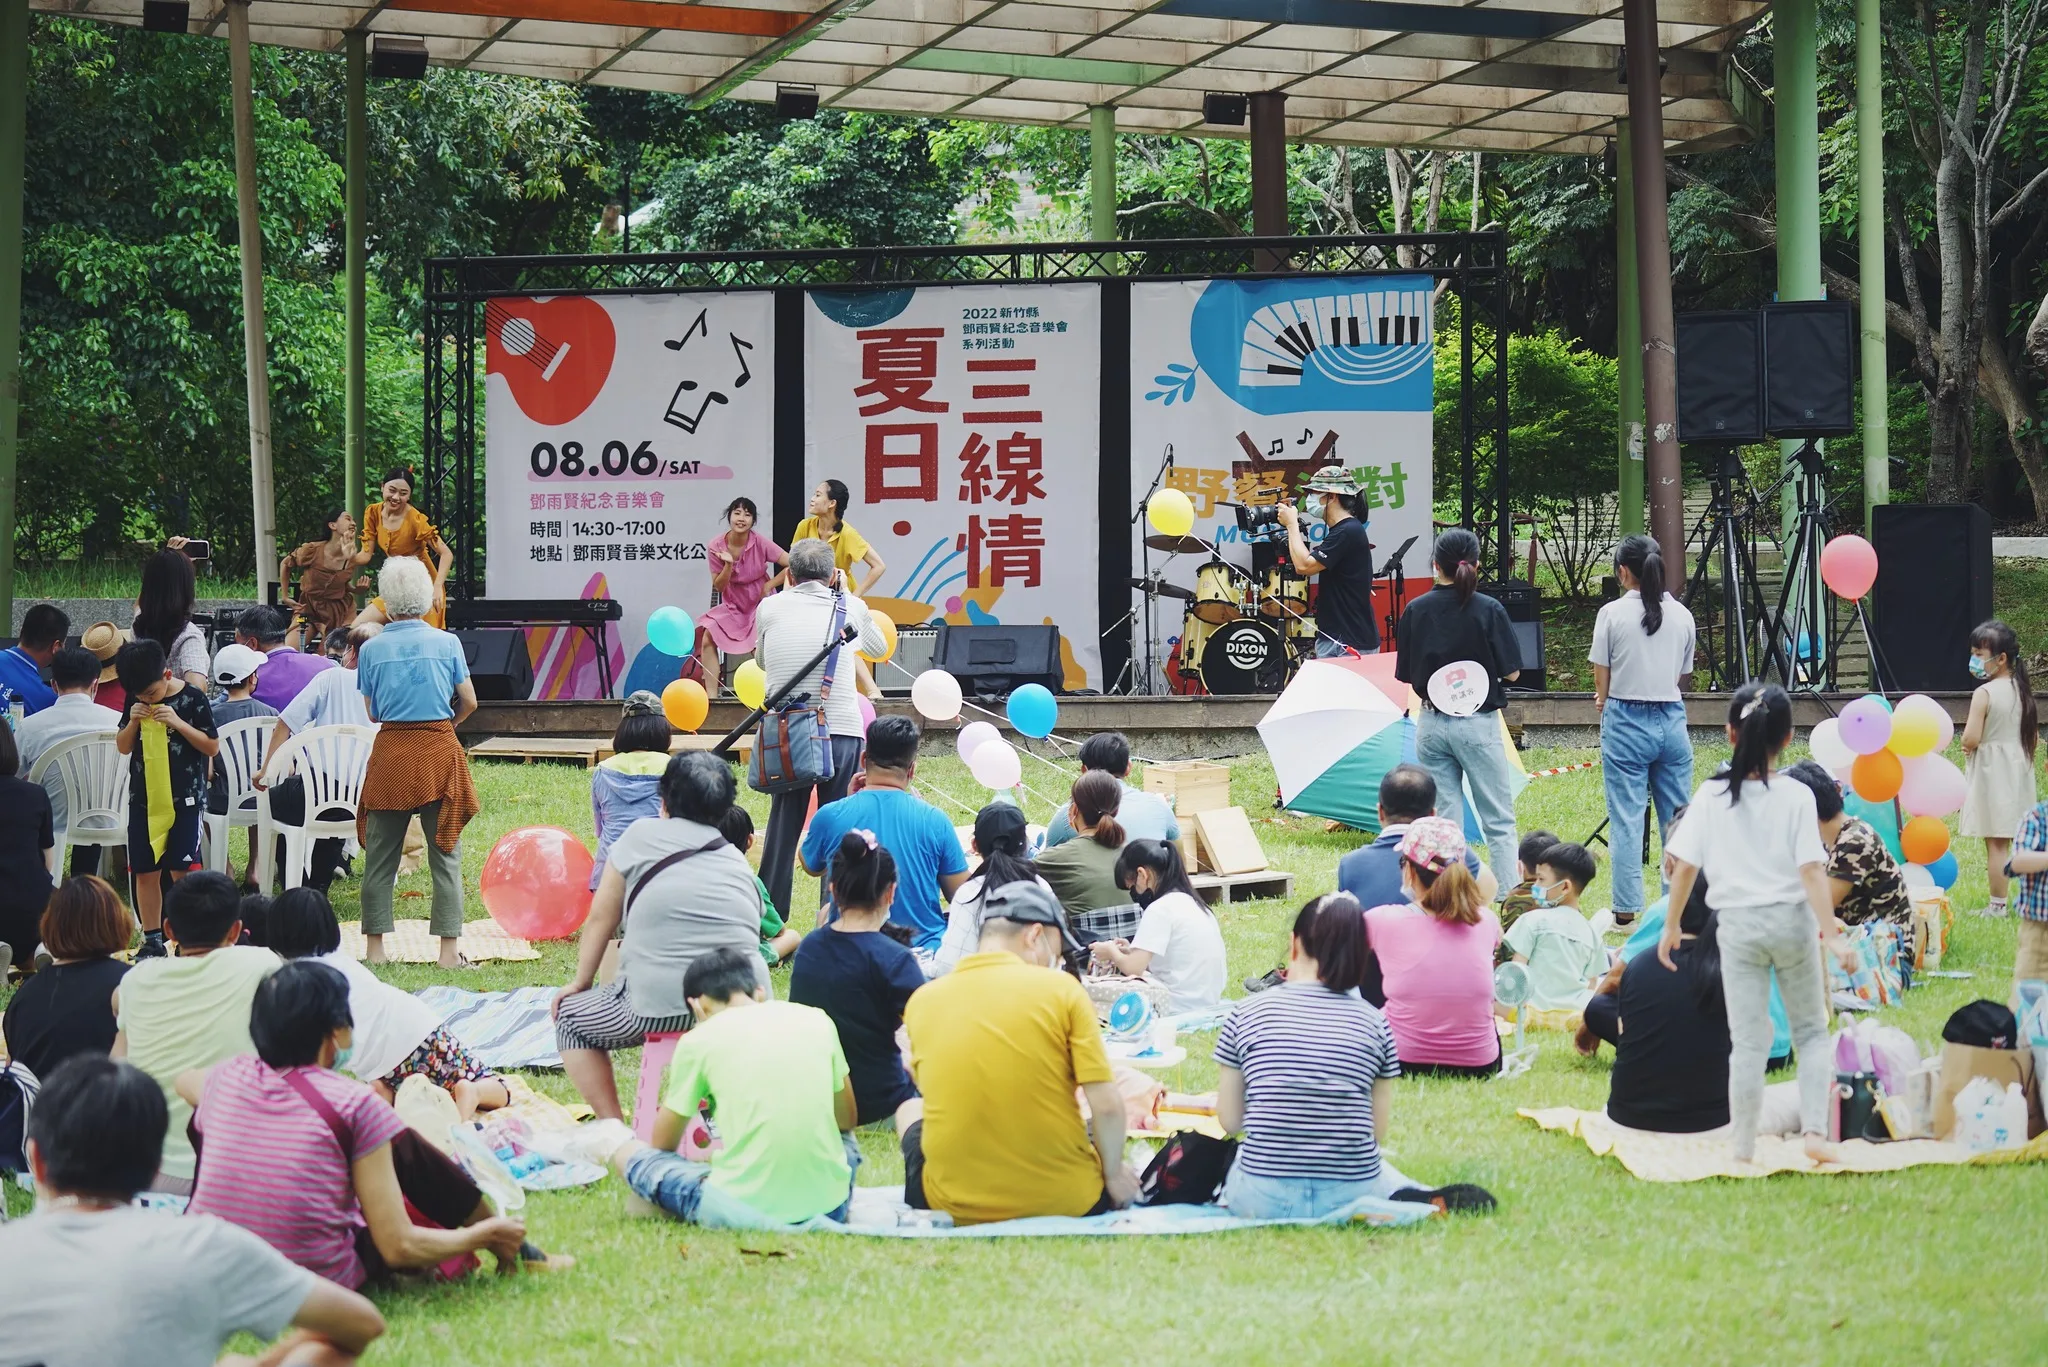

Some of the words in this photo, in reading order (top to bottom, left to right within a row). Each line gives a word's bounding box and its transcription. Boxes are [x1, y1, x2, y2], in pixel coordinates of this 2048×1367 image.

[962, 308, 997, 319] 2022
[999, 306, 1040, 318] 新竹縣
[962, 320, 1068, 334] 鄧雨賢紀念音樂會
[962, 338, 1015, 350] 系列活動
[956, 358, 1047, 588] 三線情
[529, 491, 665, 510] 鄧雨賢紀念音樂會
[529, 521, 562, 538] 時間
[572, 520, 666, 537] 14:30~17:00
[529, 545, 563, 562] 地點
[1225, 642, 1268, 656] DIXON
